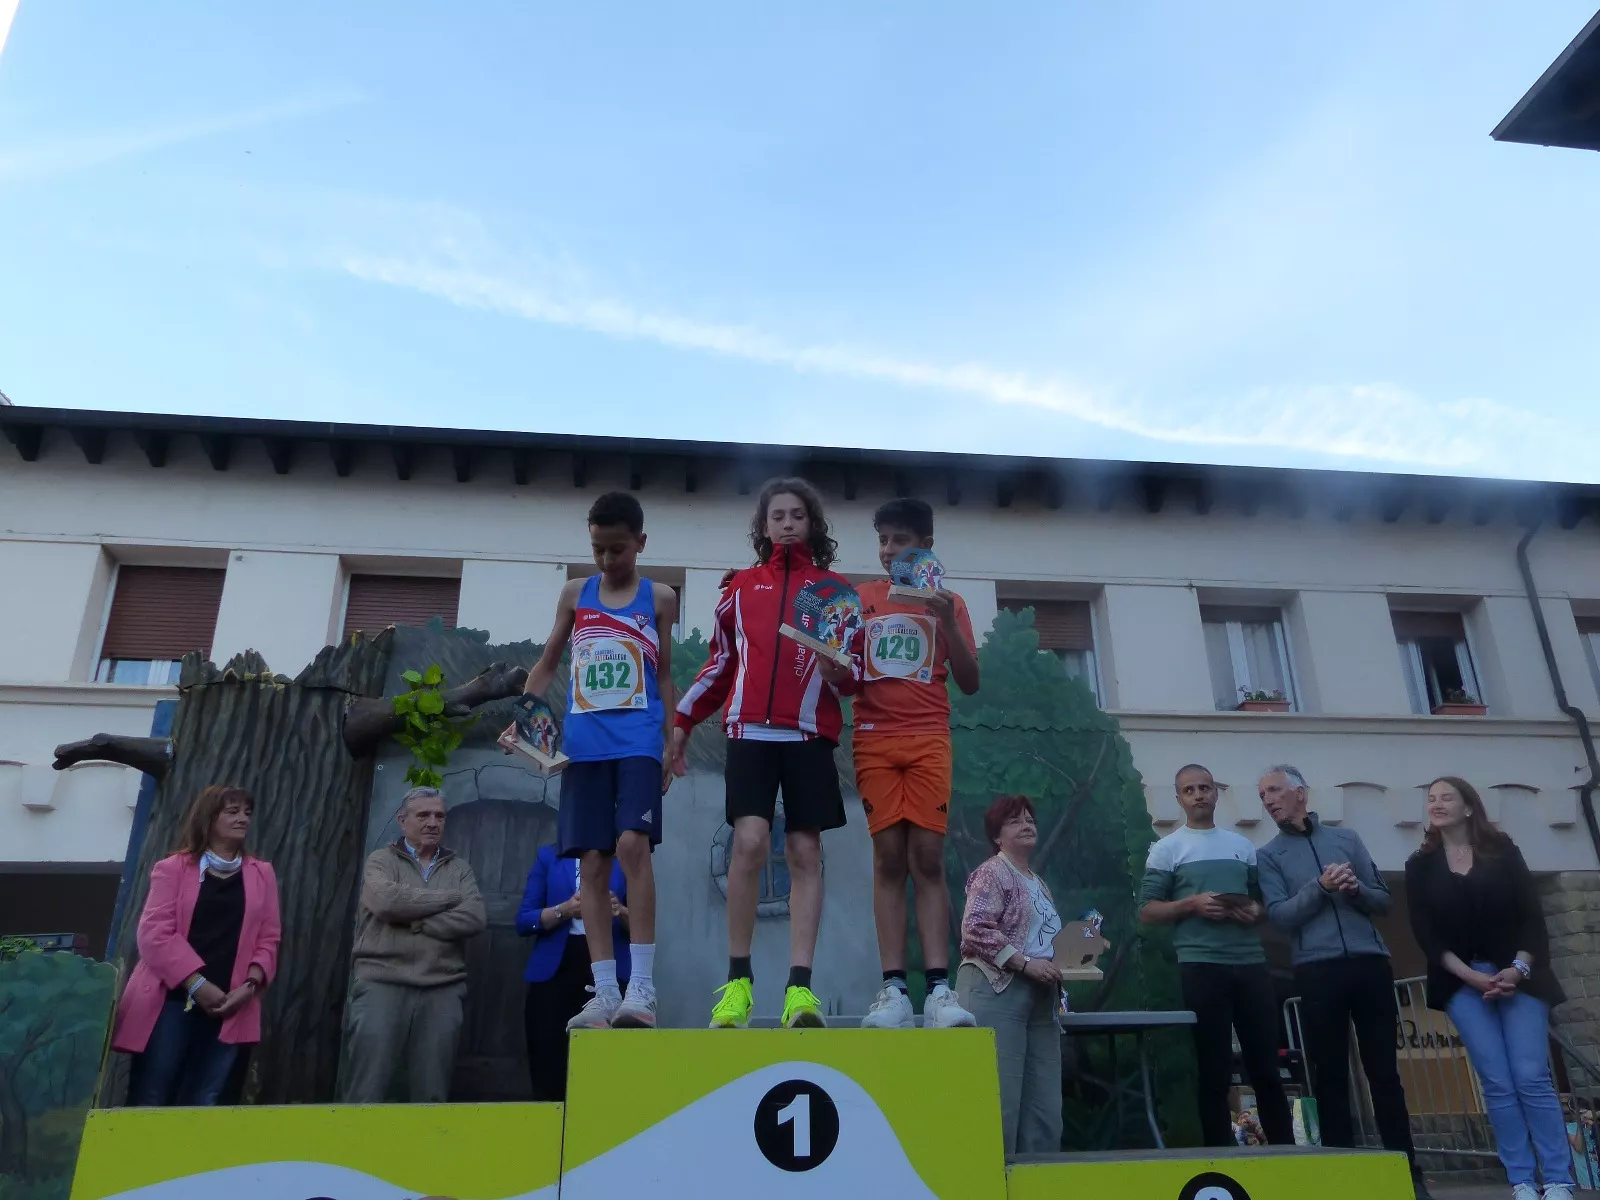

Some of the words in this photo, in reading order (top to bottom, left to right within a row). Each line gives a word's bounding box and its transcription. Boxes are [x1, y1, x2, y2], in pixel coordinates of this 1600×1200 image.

[876, 634, 920, 662] 429
[585, 662, 631, 691] 432
[777, 1093, 810, 1157] 1
